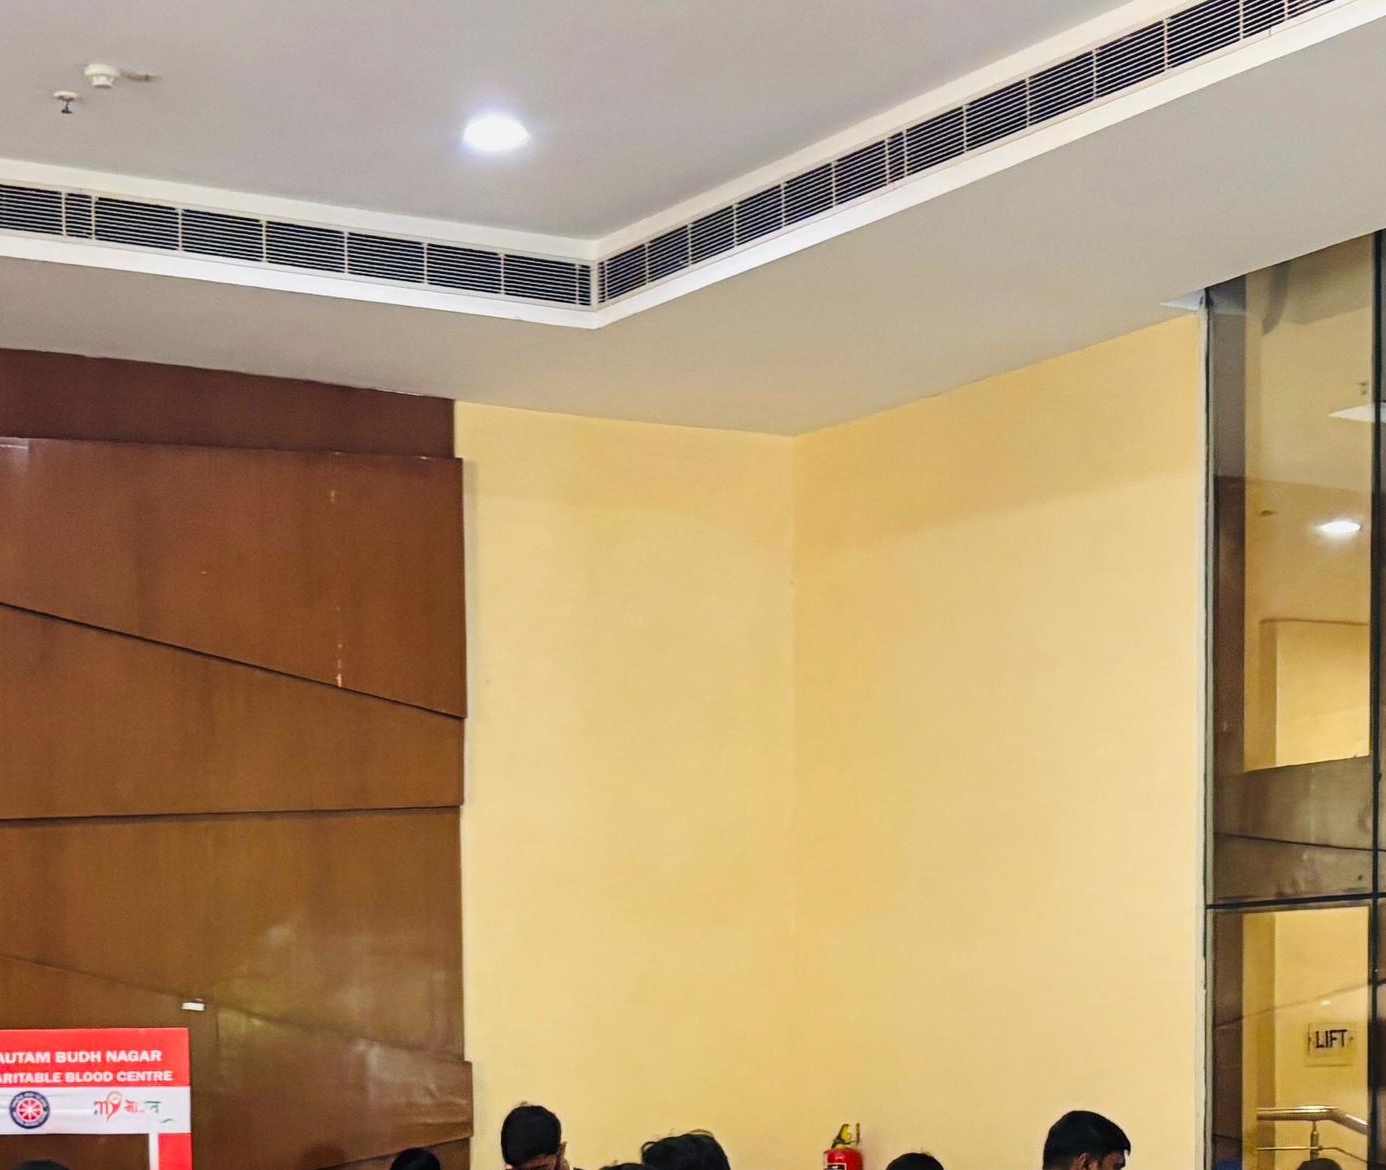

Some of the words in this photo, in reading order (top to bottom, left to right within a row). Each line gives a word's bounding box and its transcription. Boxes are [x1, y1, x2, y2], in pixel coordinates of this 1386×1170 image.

[1315, 1029, 1348, 1048] LIFT
[55, 1051, 102, 1063] BUDH
[106, 1050, 162, 1062] NAGAR
[65, 1070, 113, 1083] BLOOD
[116, 1070, 173, 1082] CENTRE
